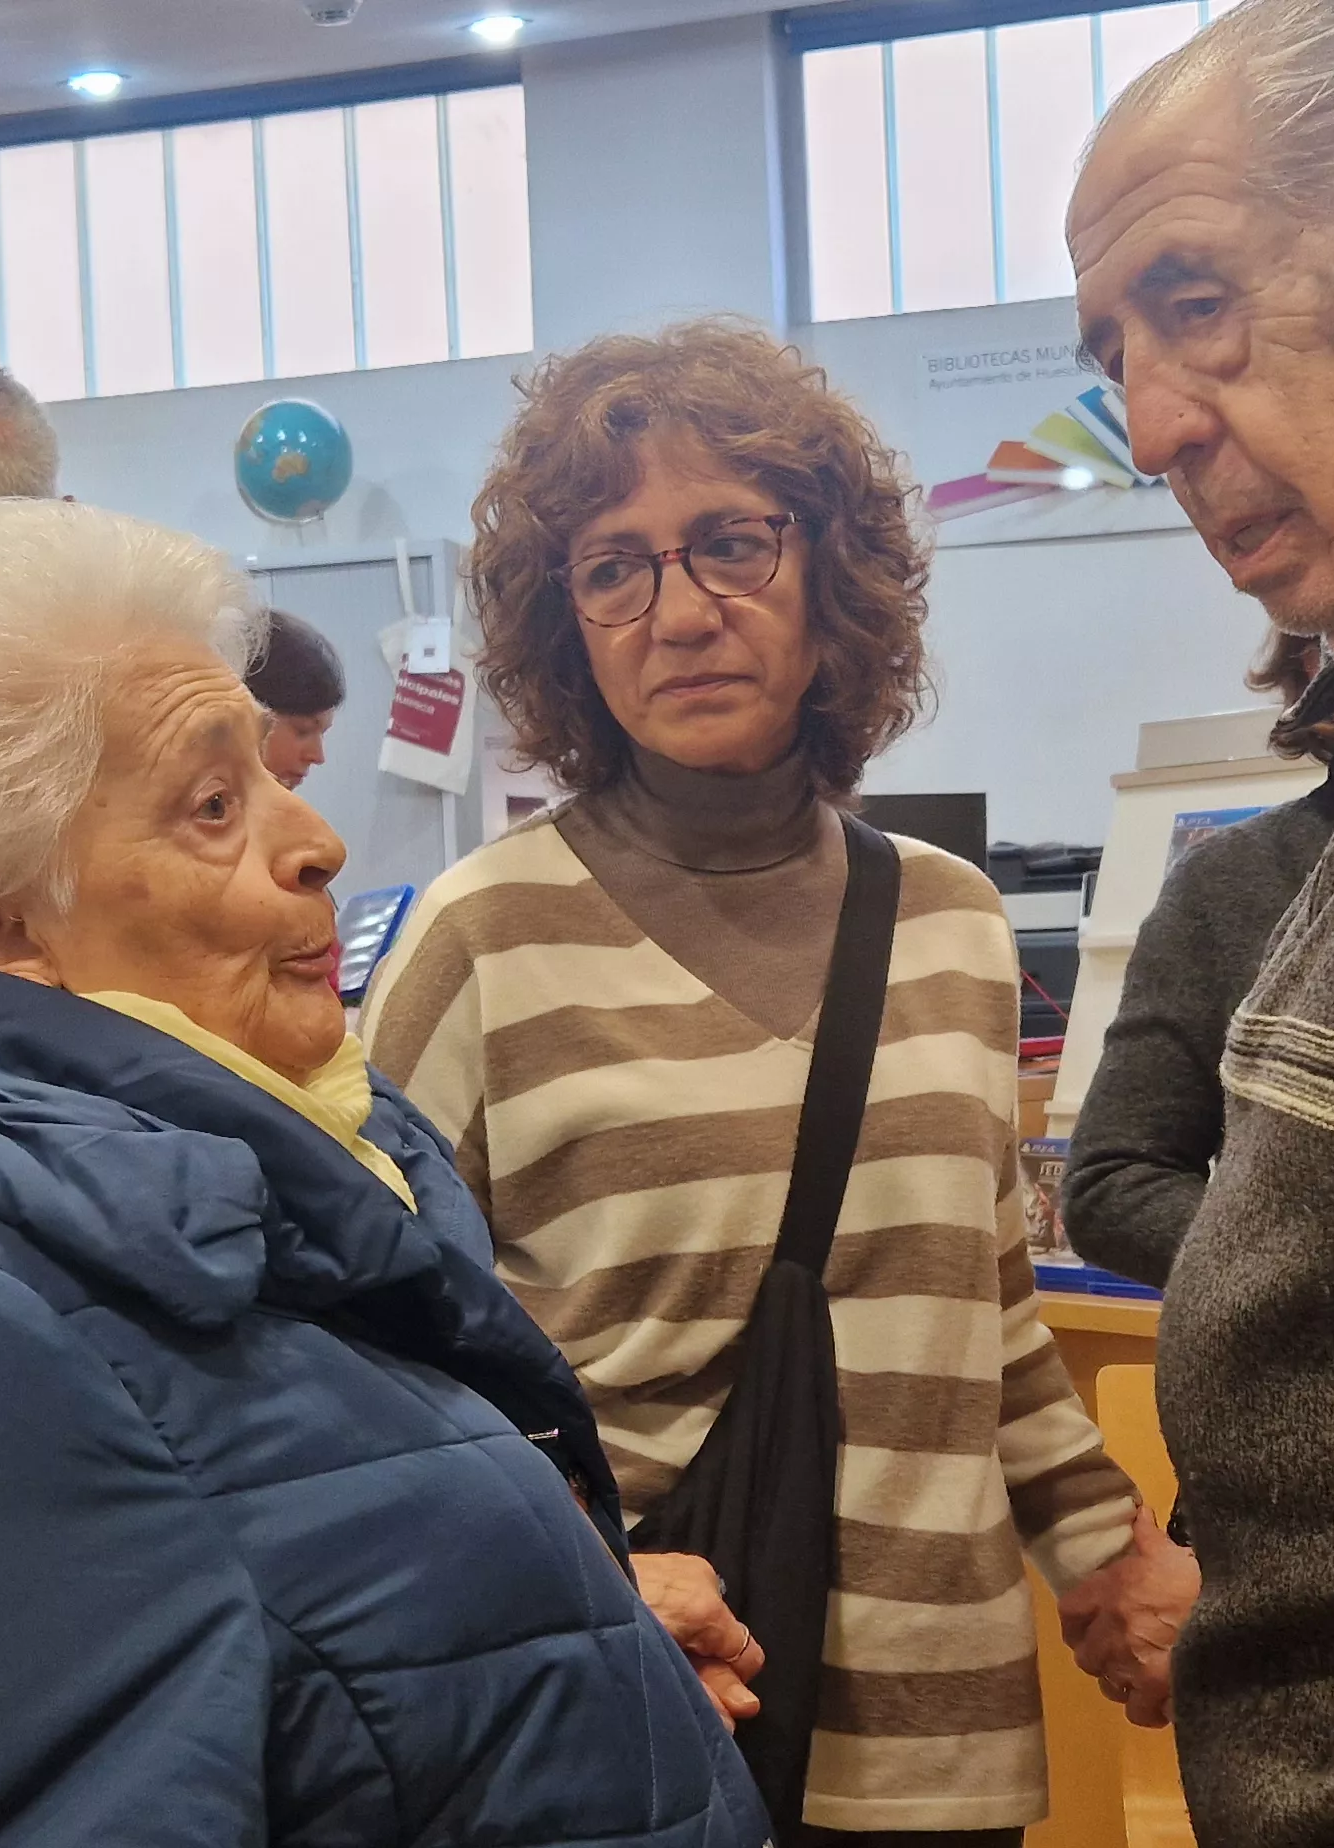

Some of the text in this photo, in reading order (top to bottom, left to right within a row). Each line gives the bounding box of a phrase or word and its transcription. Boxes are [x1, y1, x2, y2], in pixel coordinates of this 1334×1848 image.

[927, 344, 1075, 374] BIBLIOTECAS MUN
[928, 372, 1013, 392] Ayuntamiento
[1015, 369, 1032, 382] de
